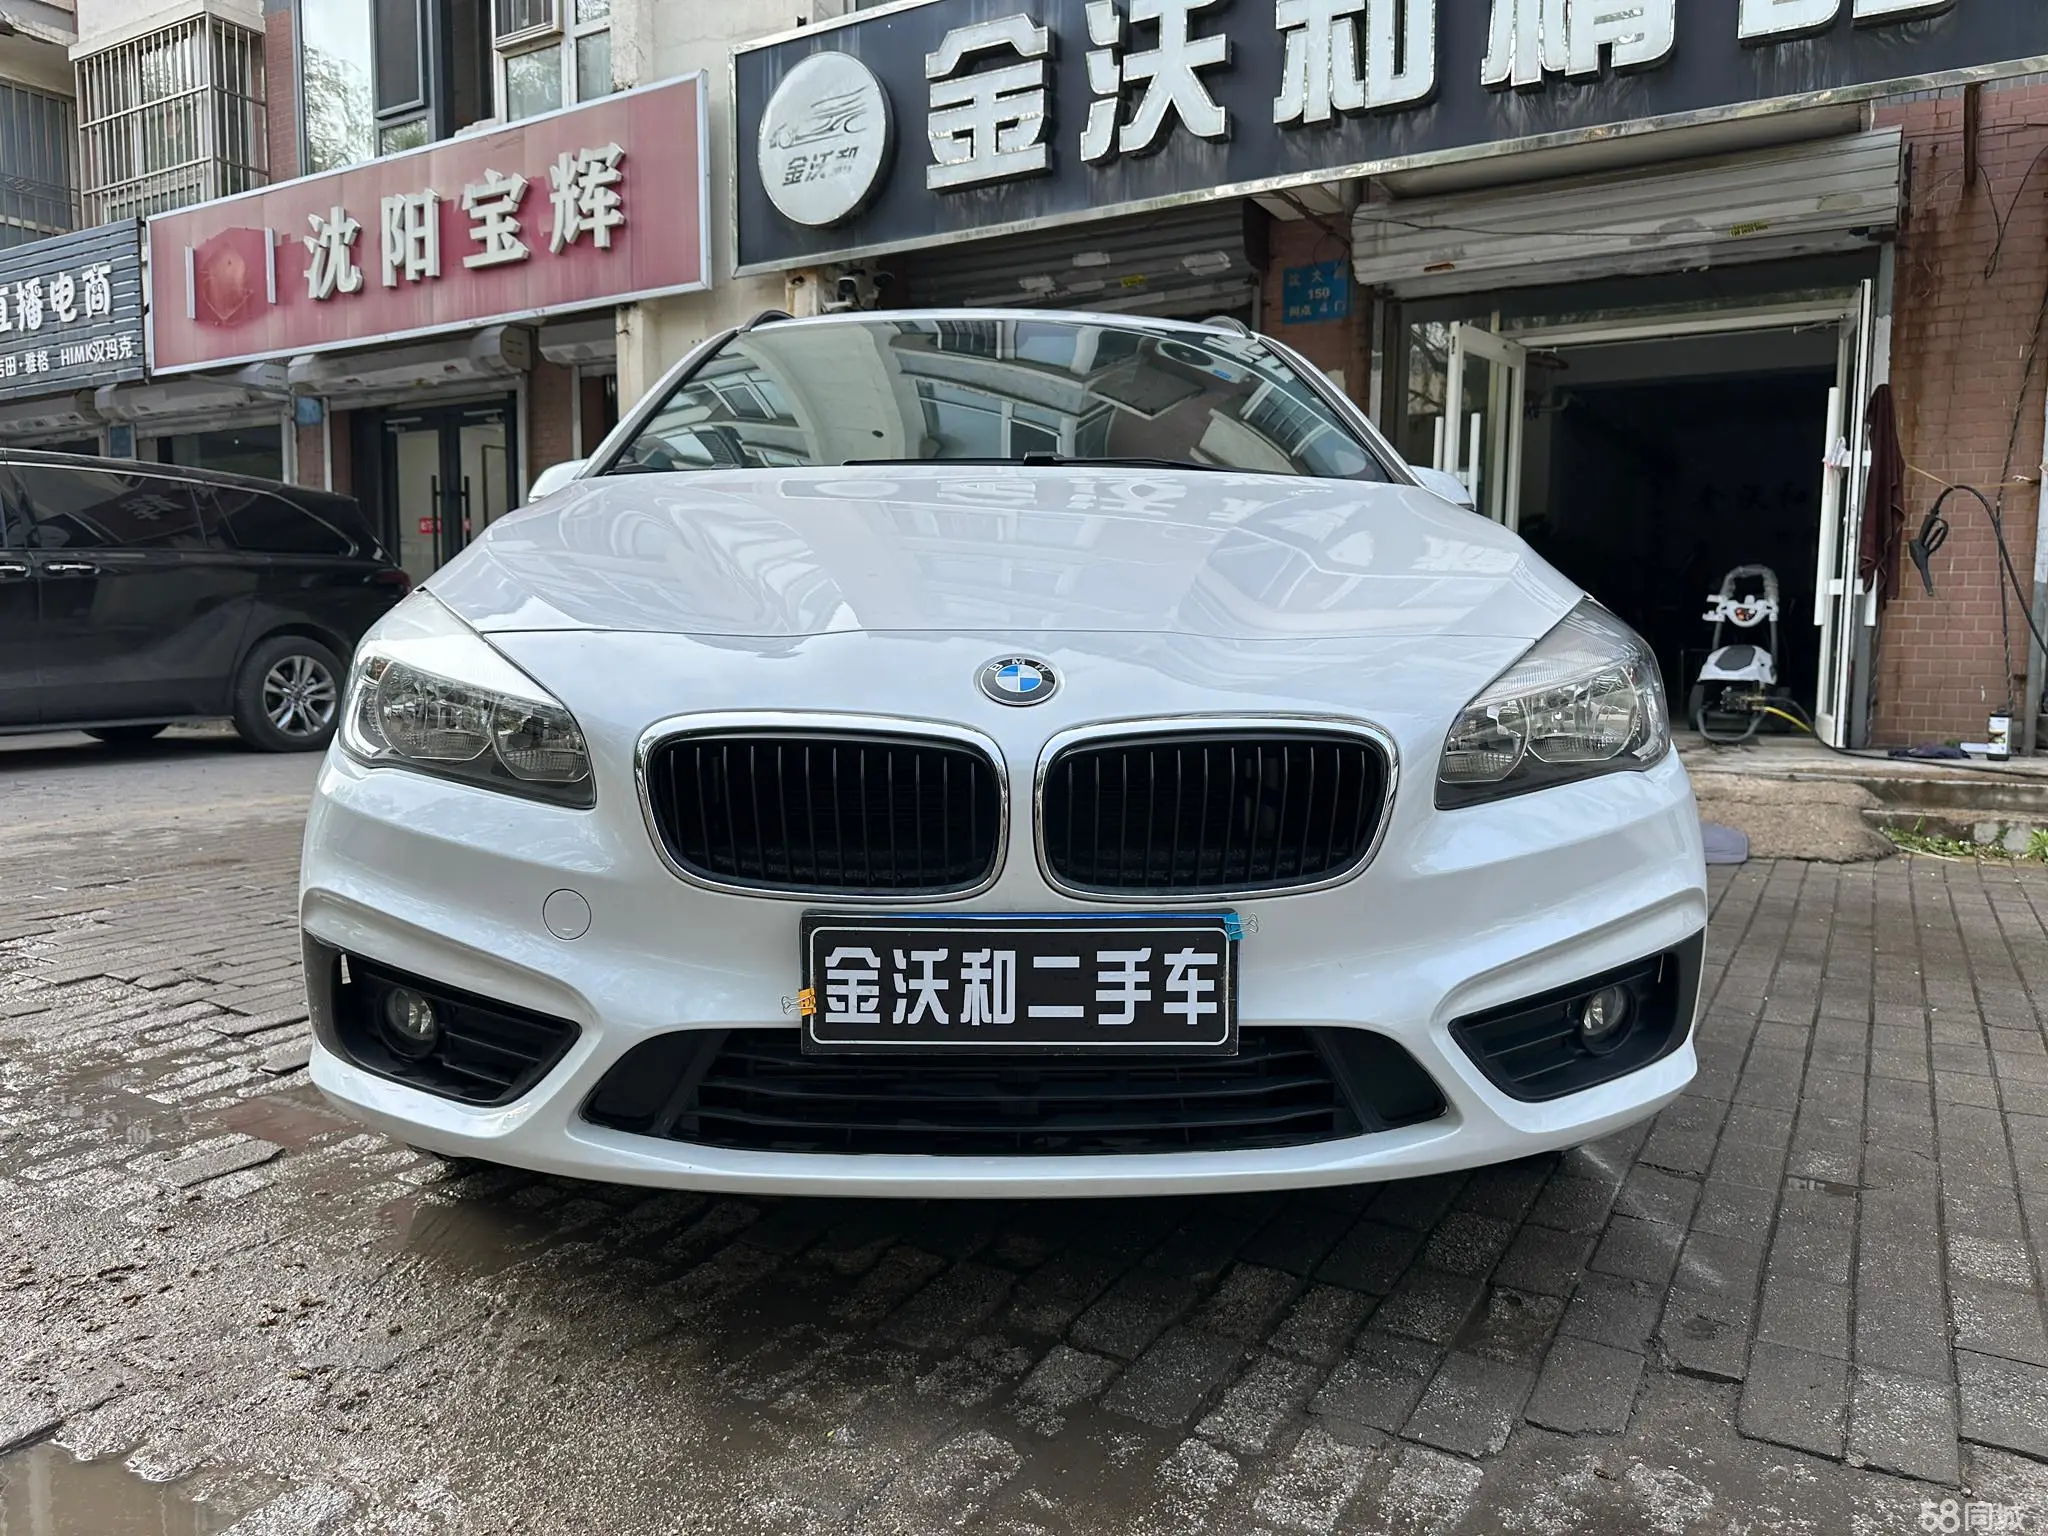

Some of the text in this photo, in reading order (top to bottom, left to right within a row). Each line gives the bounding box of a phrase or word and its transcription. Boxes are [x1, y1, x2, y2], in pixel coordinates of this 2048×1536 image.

[925, 0, 1953, 190] 金沃和
[304, 142, 627, 300] 沈阳宝辉
[1308, 287, 1330, 300] 150
[60, 335, 134, 367] HIMK汉玛克
[988, 656, 1049, 672] BMW
[824, 947, 1219, 1026] 金沃和二手车
